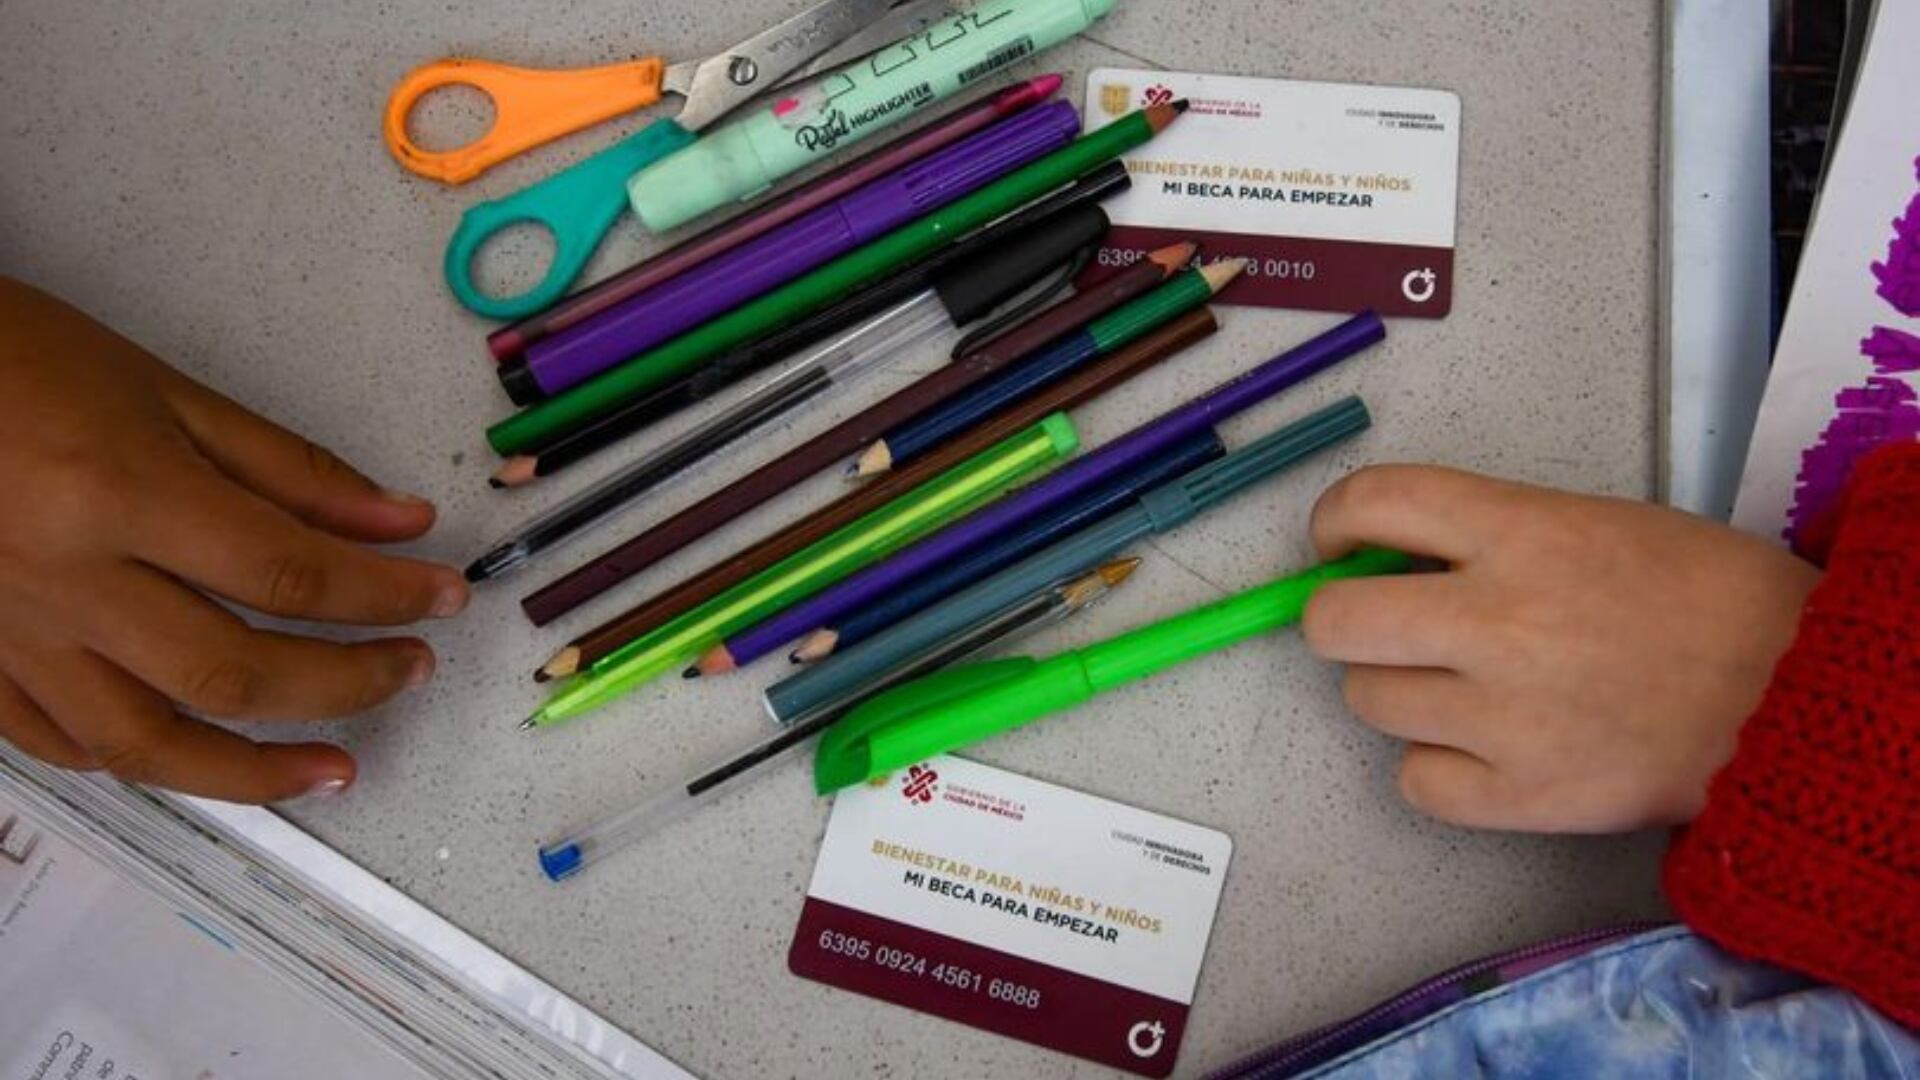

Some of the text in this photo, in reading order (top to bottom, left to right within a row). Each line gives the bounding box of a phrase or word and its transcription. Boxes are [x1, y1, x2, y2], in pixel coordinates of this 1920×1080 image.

[849, 82, 932, 129] HIGHLIGHTER
[1129, 160, 1411, 192] BIENESTAR PARA NIÑAS Y NIÑOS
[1163, 181, 1373, 208] MI BECA PARA EMPEZAR
[1264, 260, 1315, 279] 0010
[872, 839, 1161, 933] BIENESTAR PARA NIÑAS Y NIÑOS
[904, 869, 1118, 943] MI BECA PARA EMPEZAR
[818, 930, 1040, 1008] 6395 0924 4561 6888
